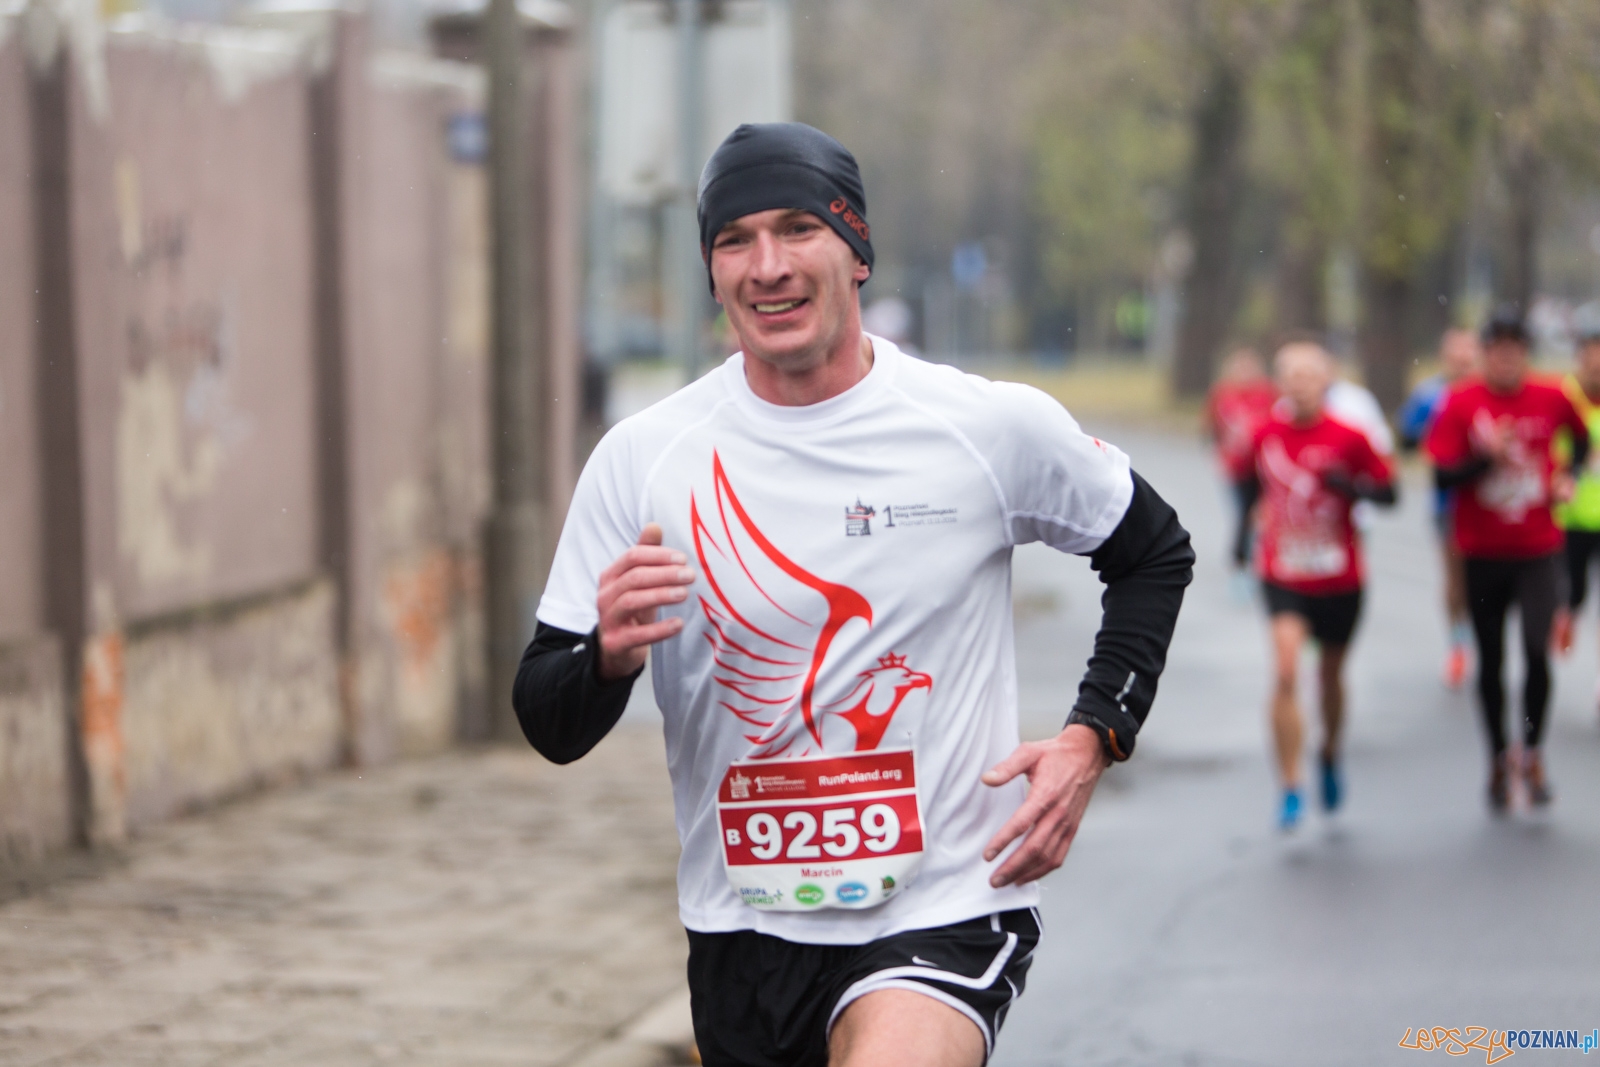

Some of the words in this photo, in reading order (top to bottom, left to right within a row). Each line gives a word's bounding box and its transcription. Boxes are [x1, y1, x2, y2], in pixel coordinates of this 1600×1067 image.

[818, 769, 902, 787] RunPoland.org
[725, 829, 741, 845] B
[746, 803, 900, 860] 9259
[801, 868, 843, 878] Marcin
